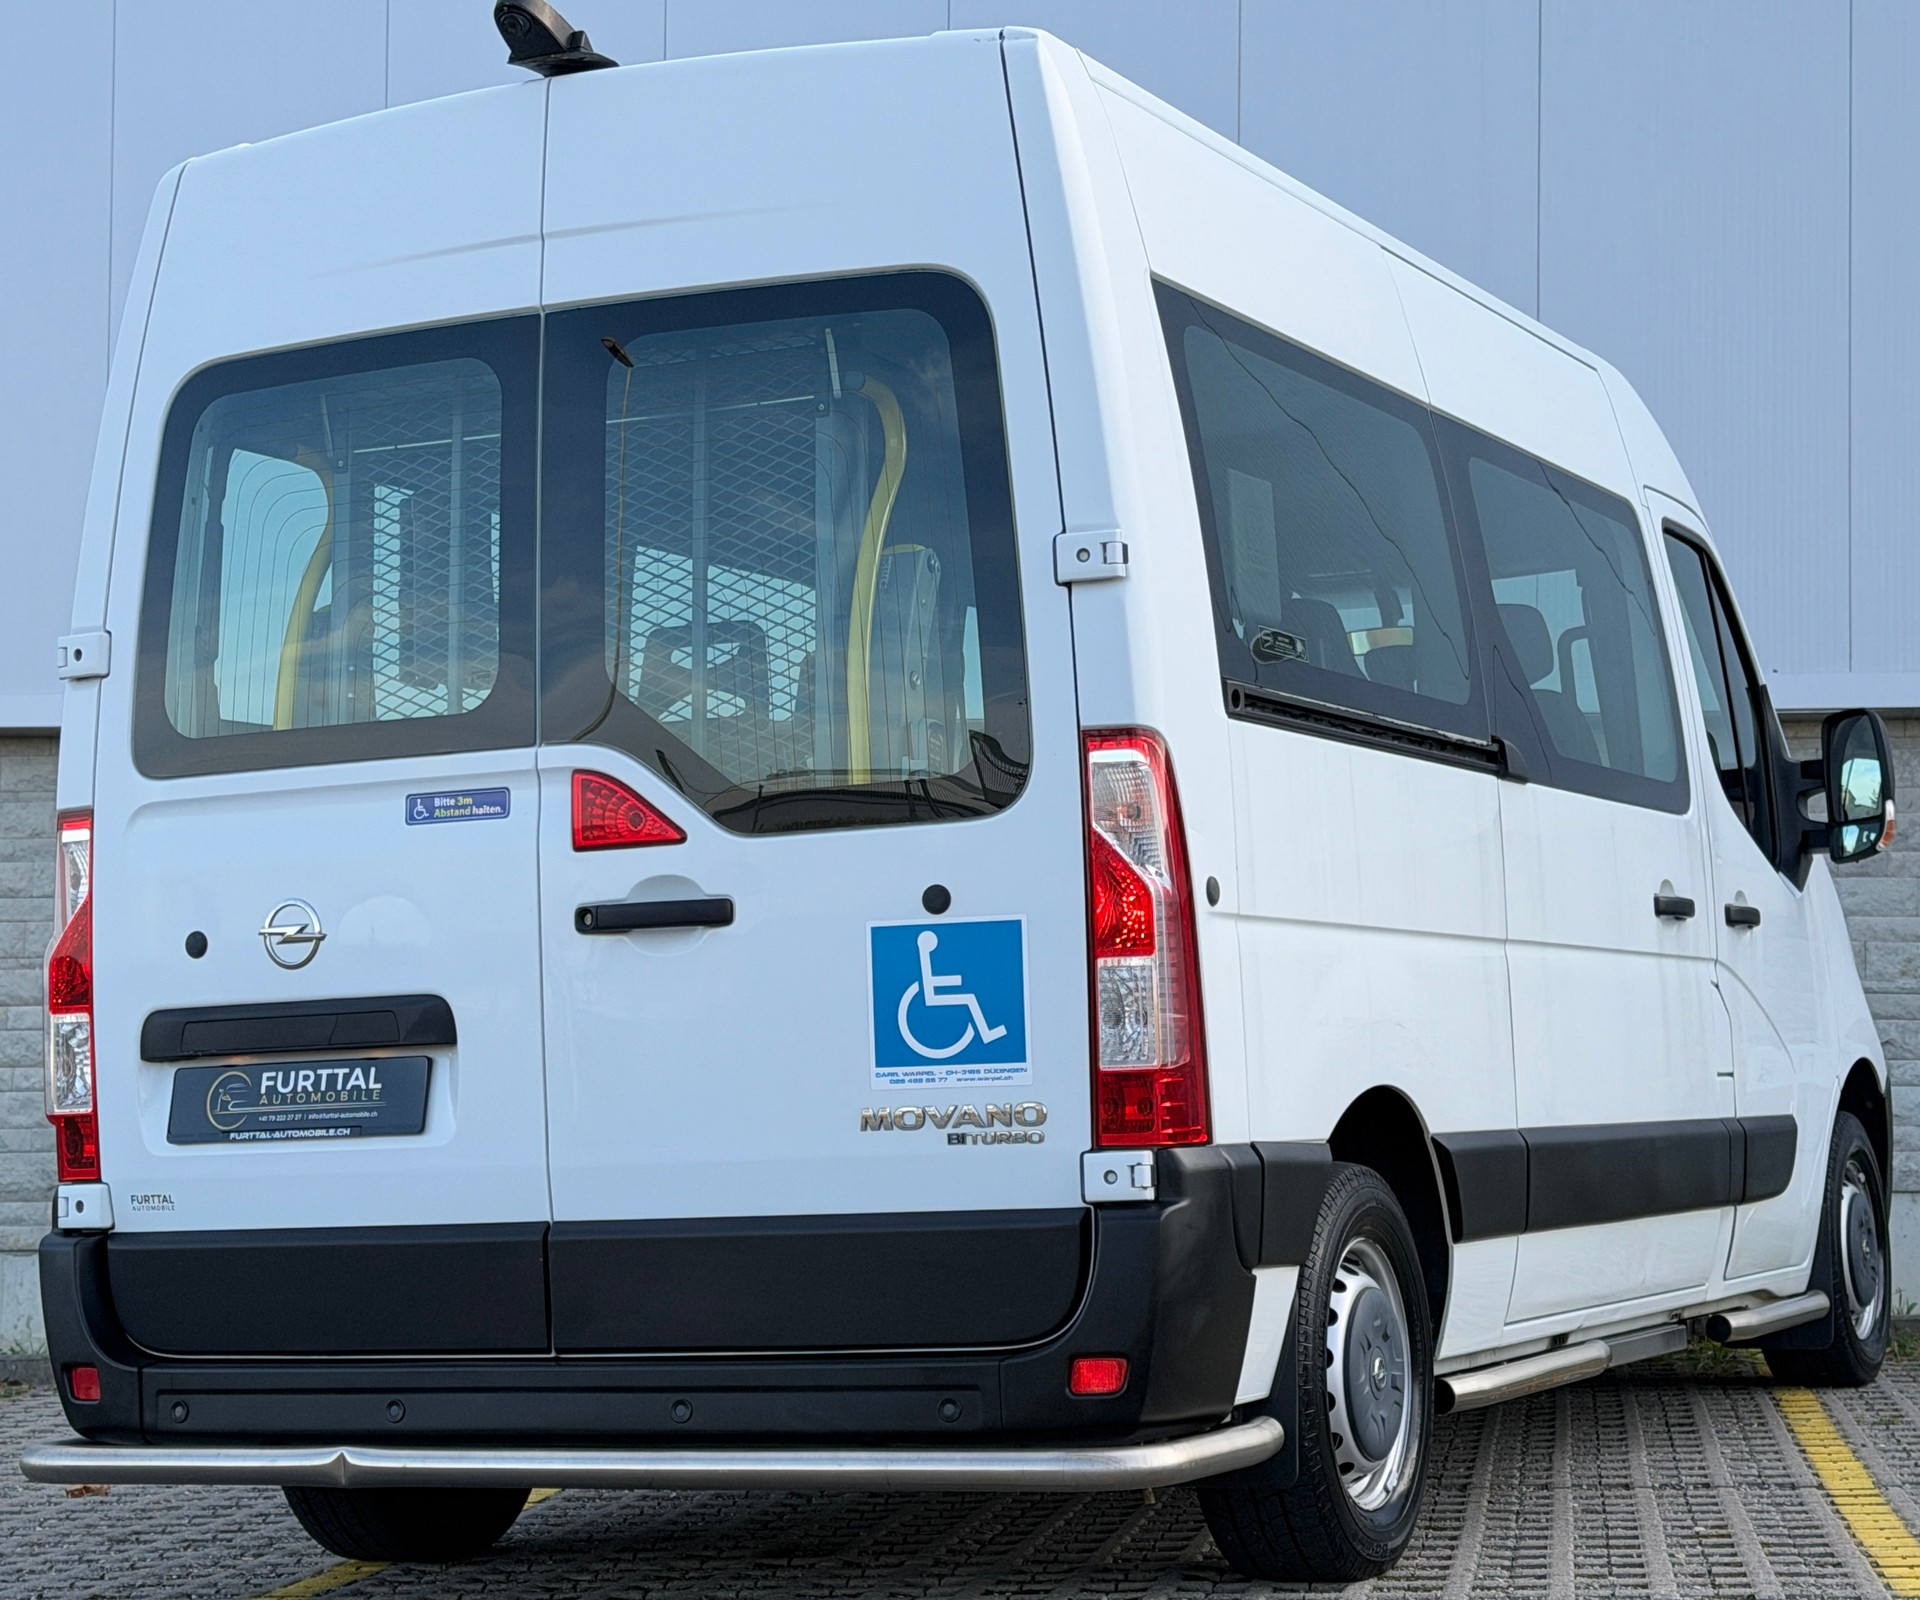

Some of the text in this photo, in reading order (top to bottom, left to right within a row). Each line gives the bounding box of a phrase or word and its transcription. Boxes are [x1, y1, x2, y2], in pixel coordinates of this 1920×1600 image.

[433, 796, 473, 807] Bitte 3m
[433, 805, 504, 818] Abstand halten.
[259, 1066, 383, 1094] FURTTAL
[259, 1089, 382, 1105] AUTOMOBILE
[859, 1101, 1048, 1132] MOVANO
[229, 1128, 350, 1140] FURTTAL-AUTOMOBILE.CH
[947, 1131, 1045, 1146] BITURBO
[130, 1194, 175, 1205] FURTTAL
